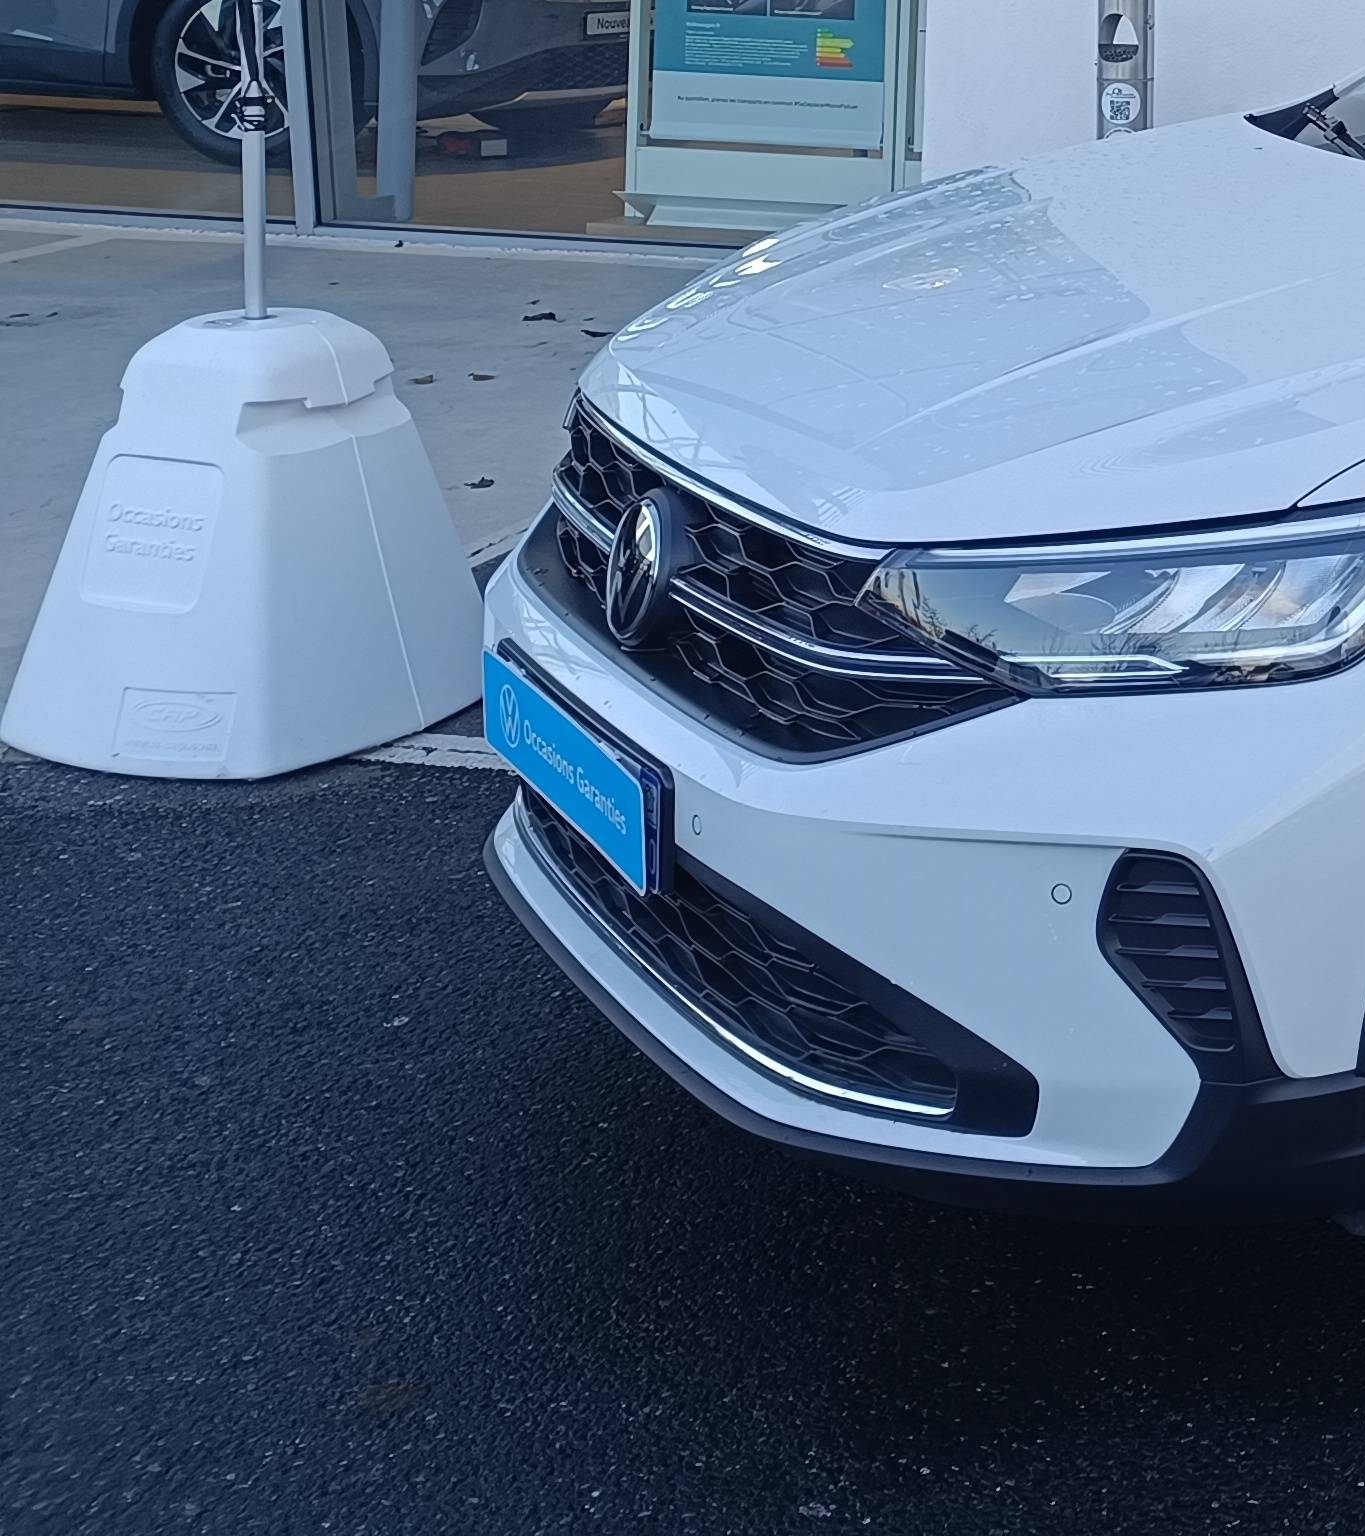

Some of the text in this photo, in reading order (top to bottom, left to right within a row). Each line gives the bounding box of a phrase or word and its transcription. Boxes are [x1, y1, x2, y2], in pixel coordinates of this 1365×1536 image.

[108, 502, 204, 532] Occasions
[104, 532, 196, 562] Garanties
[523, 719, 628, 836] Occasions Garanties
